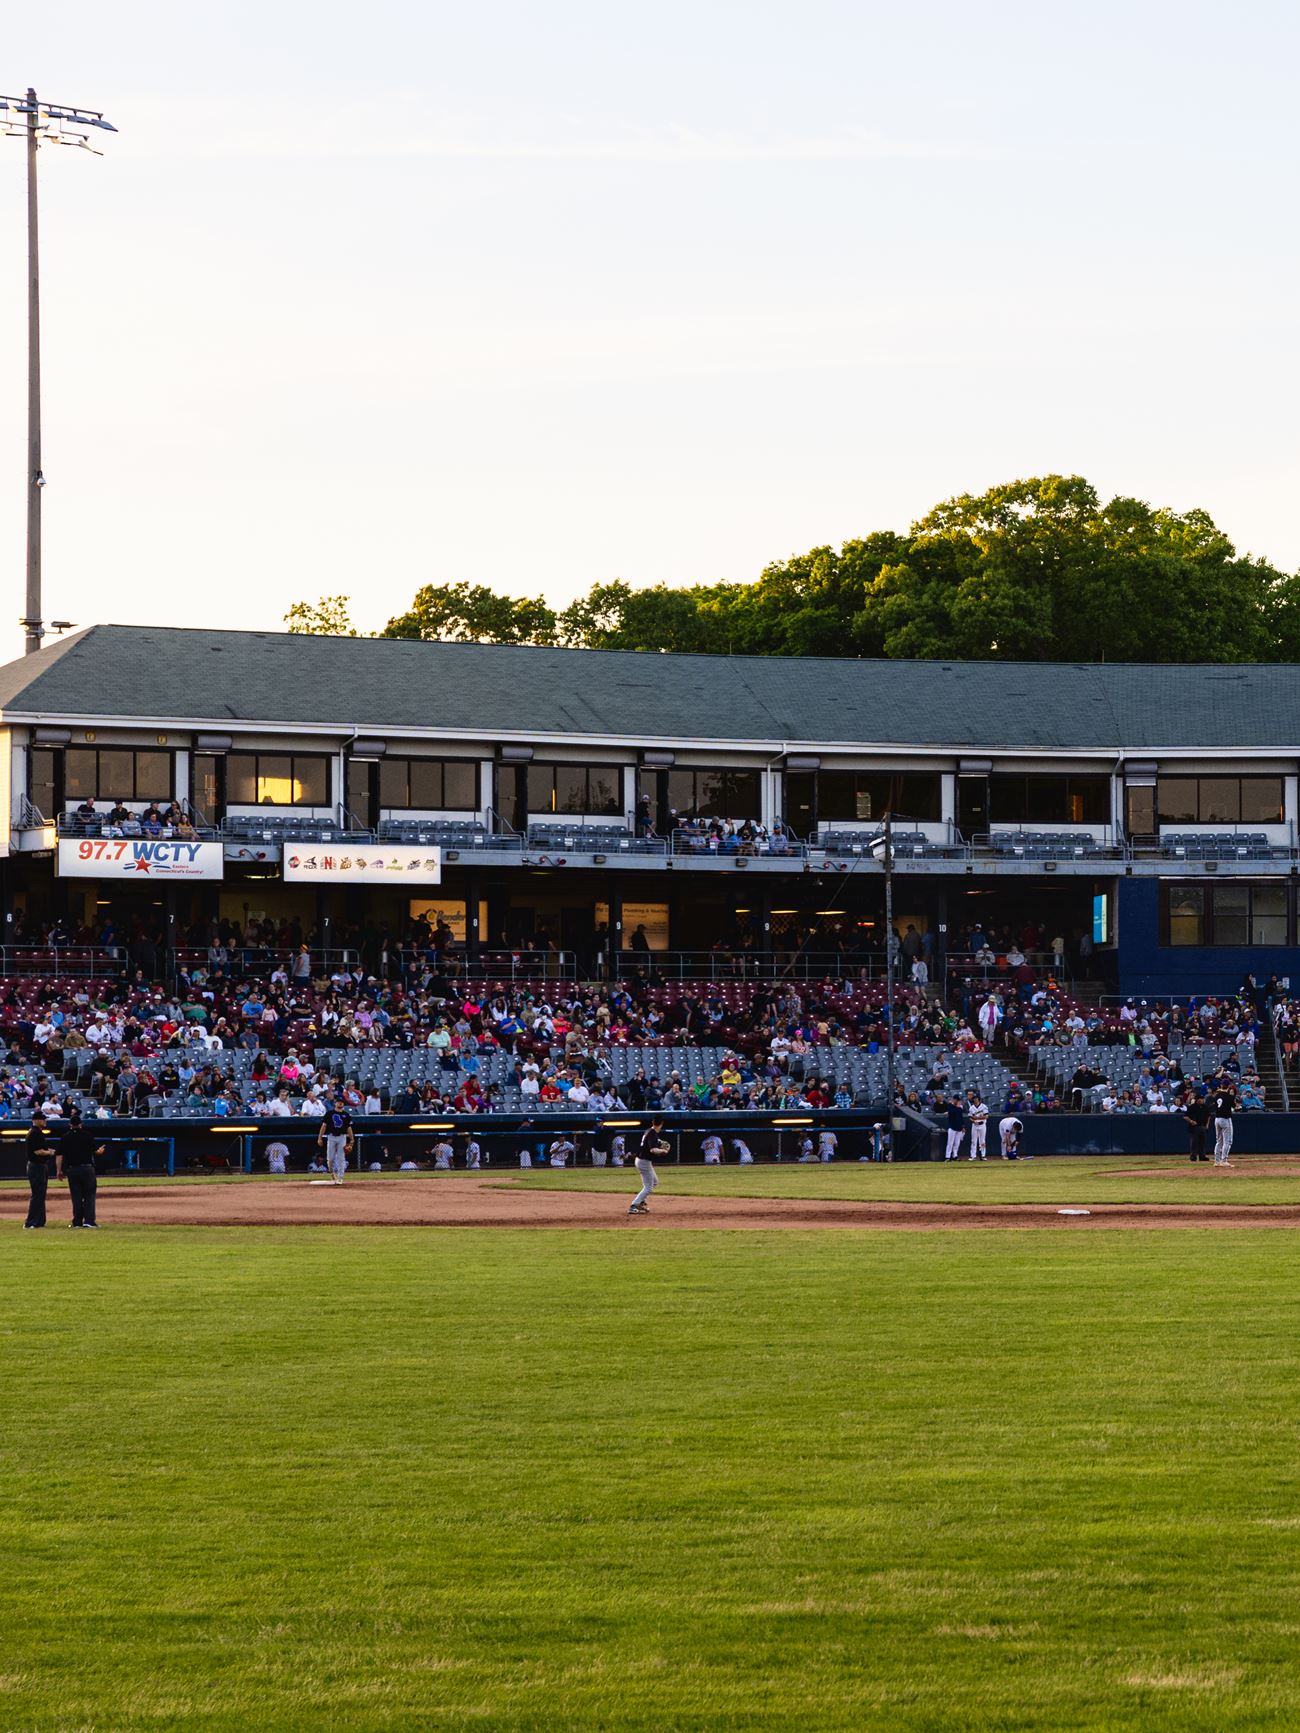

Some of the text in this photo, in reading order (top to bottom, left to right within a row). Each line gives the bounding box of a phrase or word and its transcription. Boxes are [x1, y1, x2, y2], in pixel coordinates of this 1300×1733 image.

[78, 841, 202, 862] 97.7 WCTY
[7, 913, 12, 923] 6
[169, 914, 174, 924] 7
[324, 918, 329, 927] 7
[473, 918, 478, 927] 8
[616, 921, 621, 930] 9
[764, 922, 770, 931] 9
[939, 924, 946, 932] 10
[1216, 1098, 1223, 1108] 9
